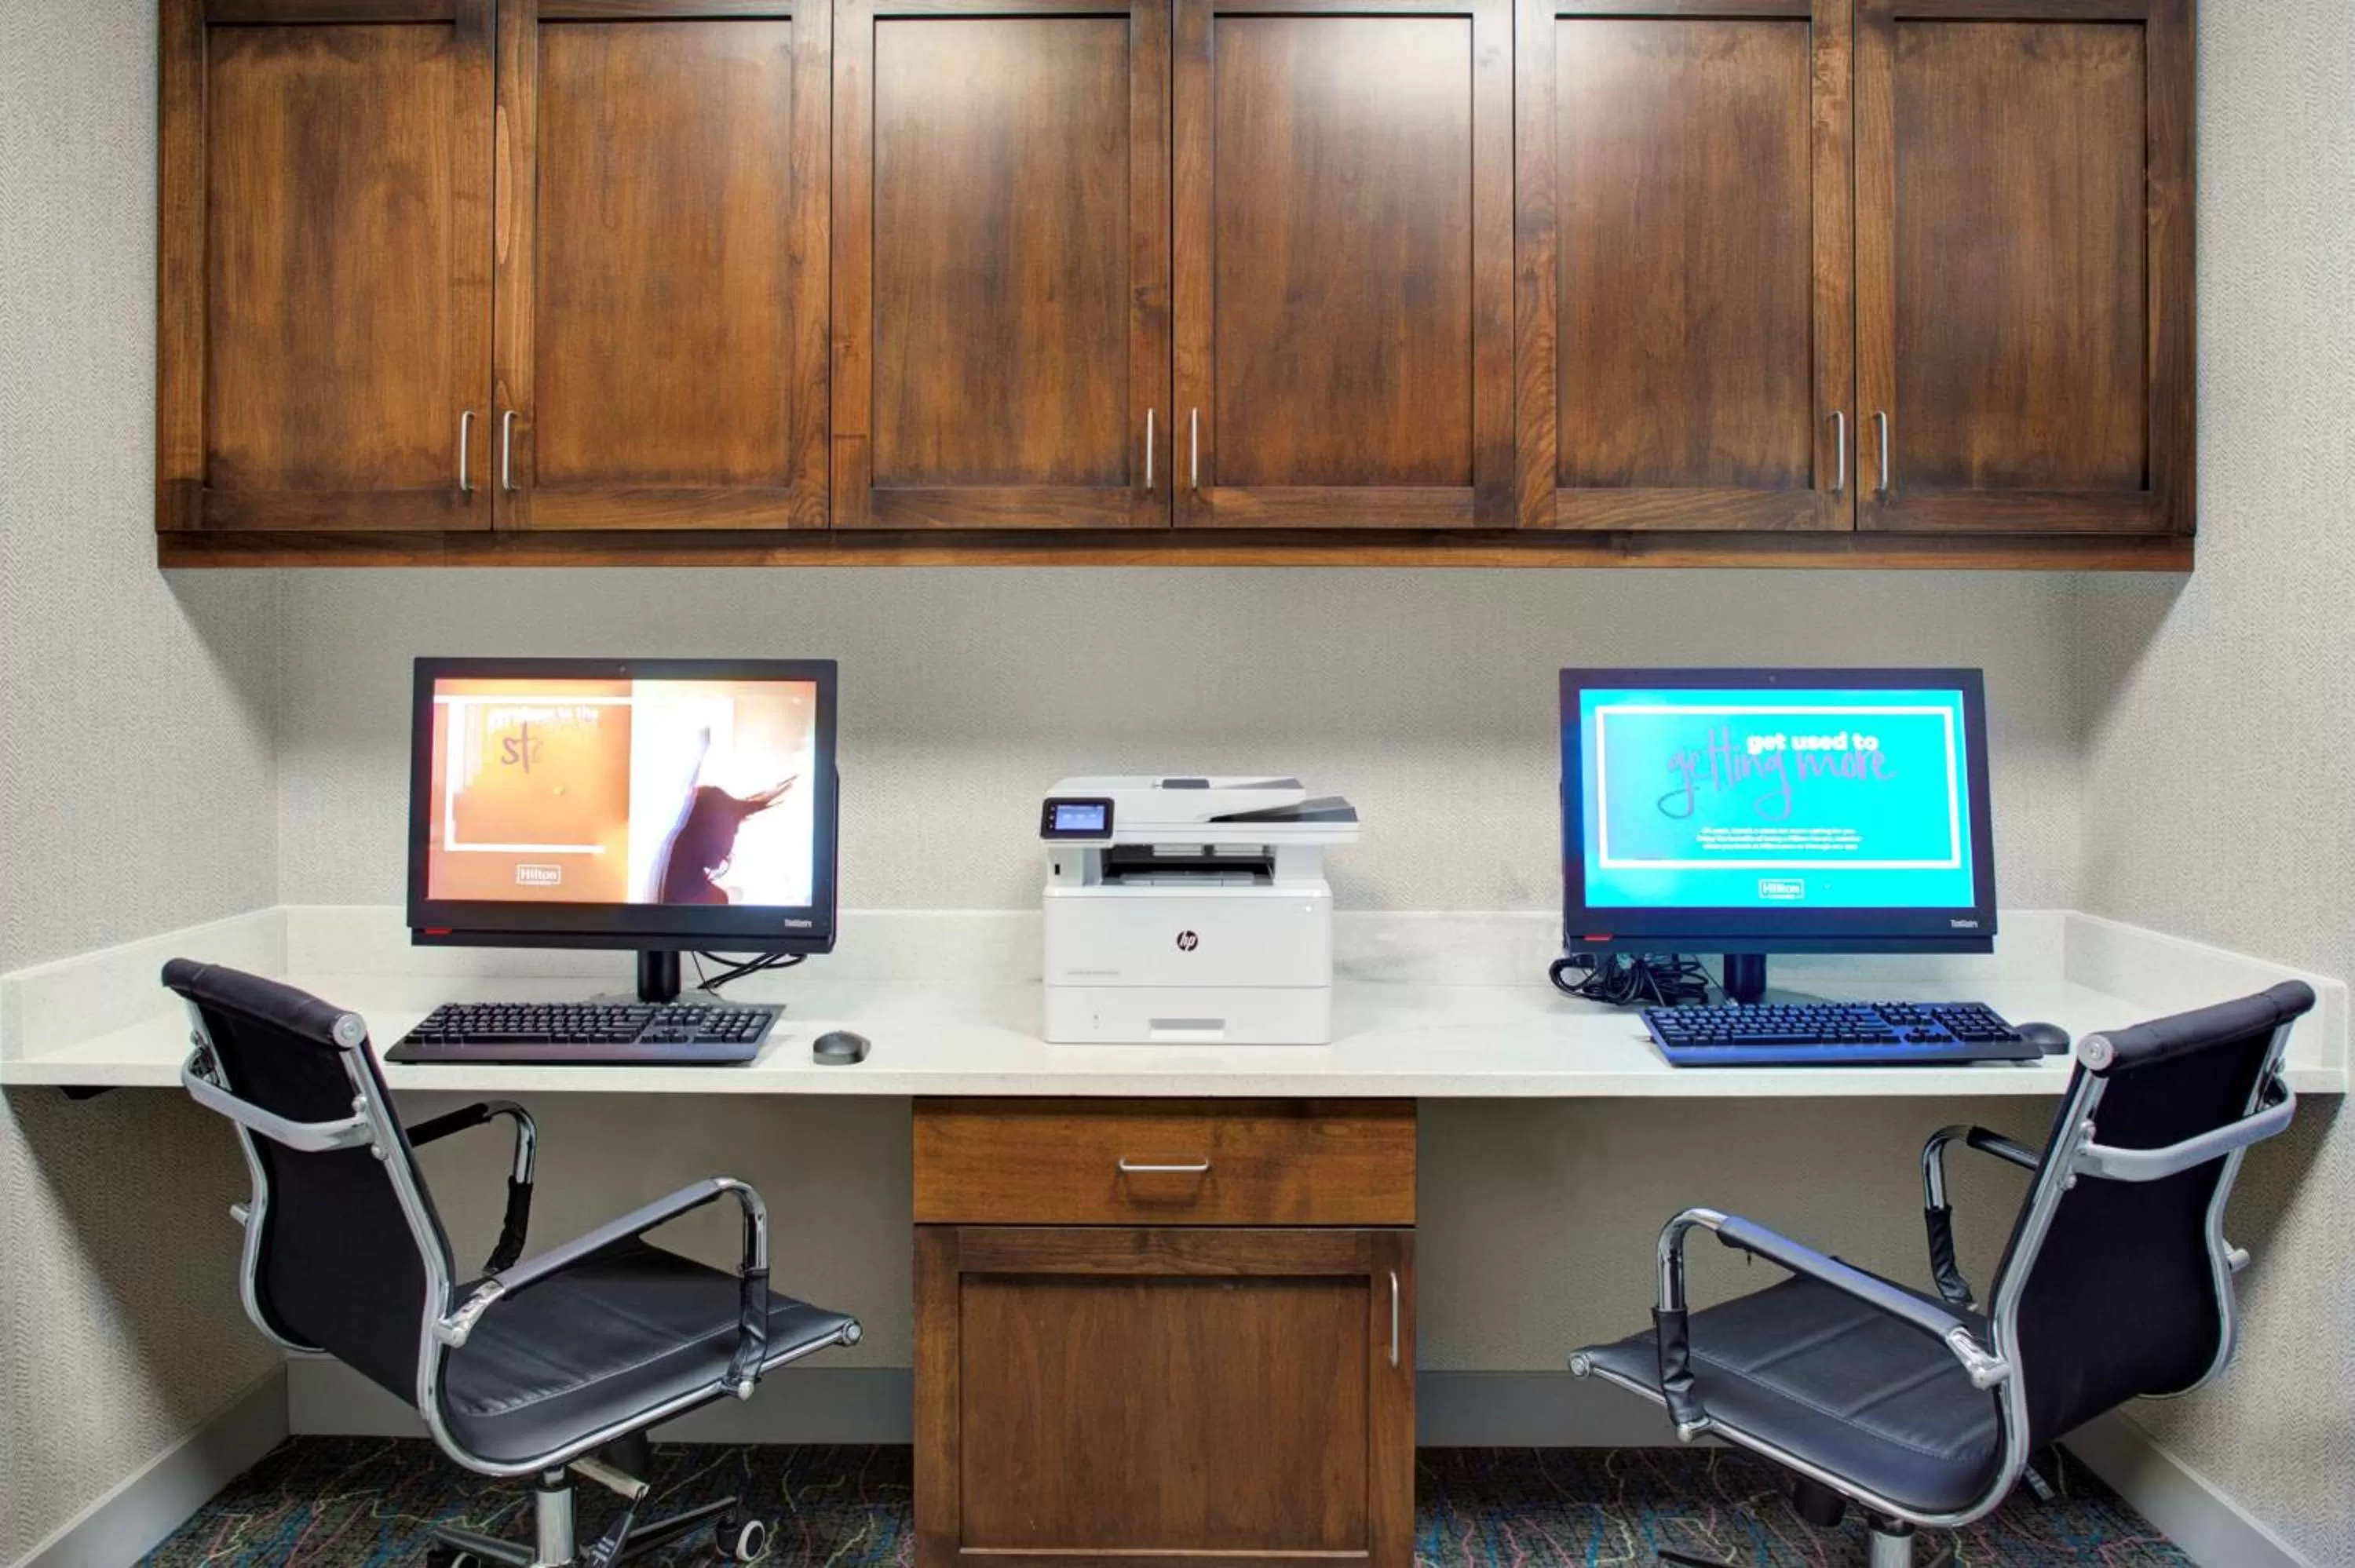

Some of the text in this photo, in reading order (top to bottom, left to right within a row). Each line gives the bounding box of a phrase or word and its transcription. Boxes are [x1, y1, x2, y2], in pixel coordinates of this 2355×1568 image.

[1747, 731, 1879, 754] get used to
[1656, 727, 1897, 822] getting more
[520, 868, 557, 880] Hilton
